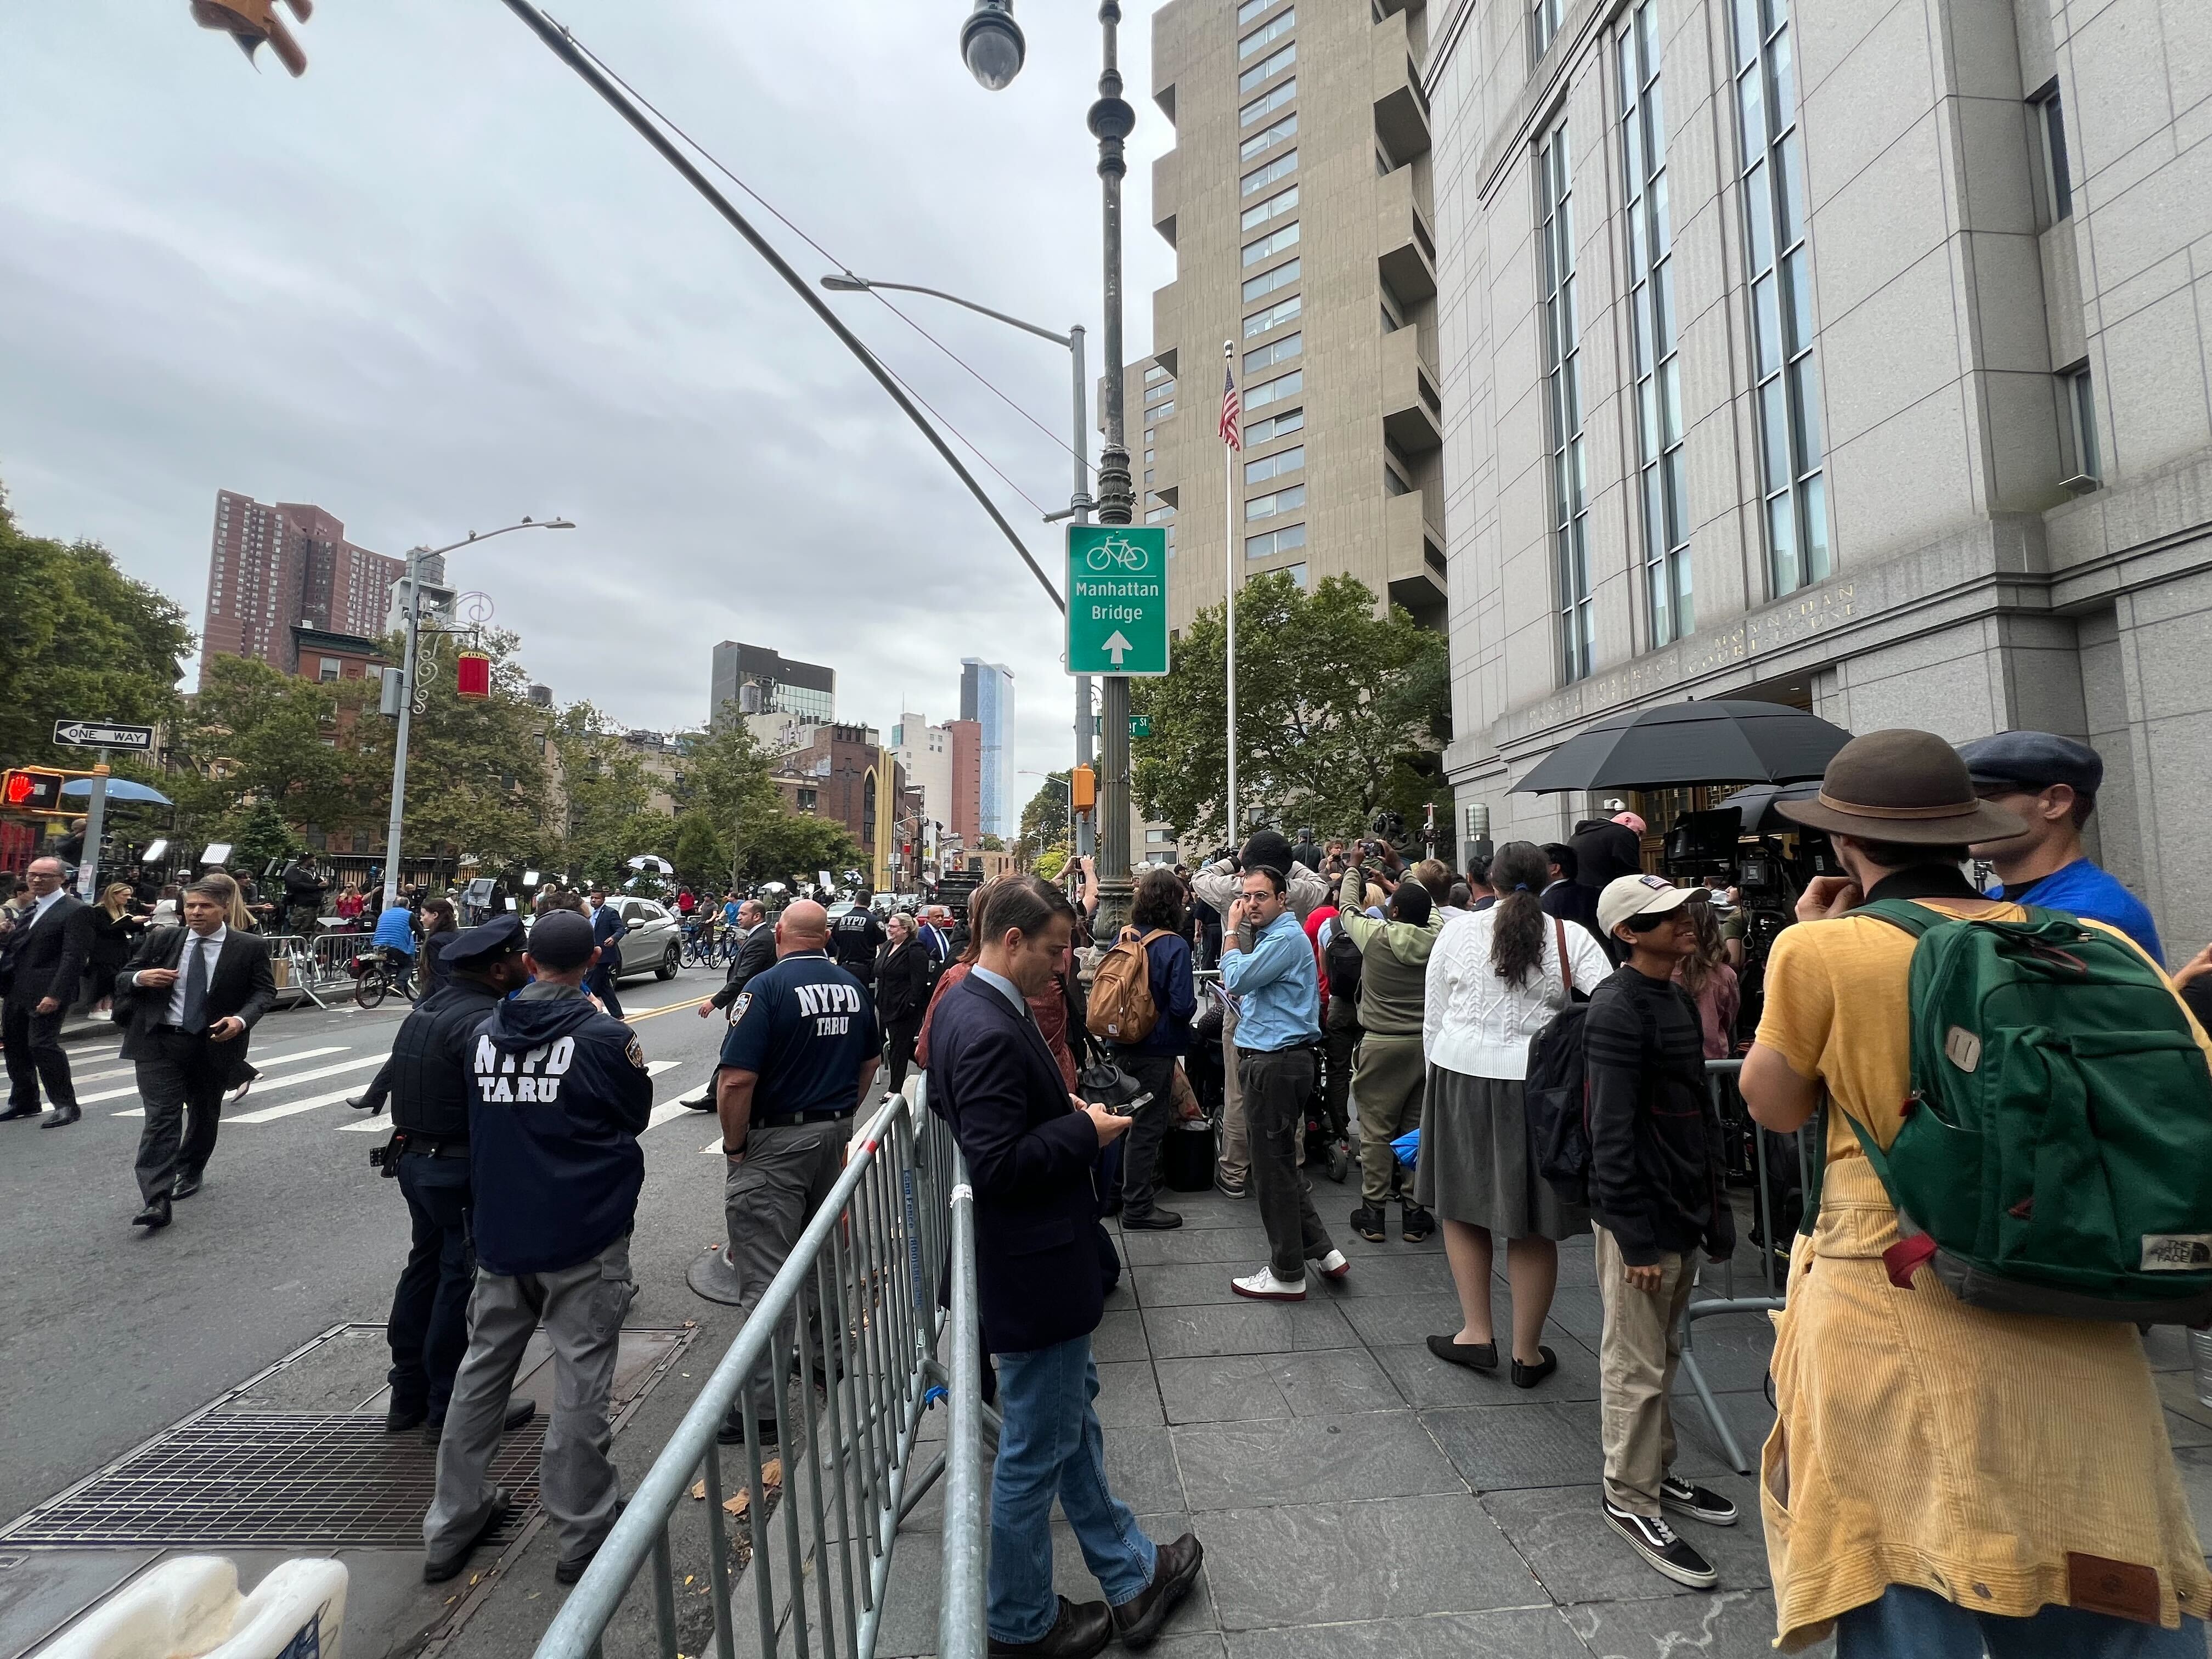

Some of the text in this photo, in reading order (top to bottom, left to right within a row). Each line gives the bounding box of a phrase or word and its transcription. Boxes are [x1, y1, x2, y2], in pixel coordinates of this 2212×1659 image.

[1076, 582, 1159, 596] Manhattan
[1092, 605, 1143, 623] Bridge
[1714, 583, 1854, 648] MOYNIHAN
[1689, 637, 1760, 674] COURT
[1139, 717, 1147, 726] St
[69, 729, 143, 742] ONE WAY
[839, 916, 867, 926] NYPD
[794, 984, 860, 1017] NYPD
[816, 1017, 849, 1036] TARU
[478, 1077, 560, 1103] TARU
[906, 1197, 914, 1229] Fence
[2157, 1254, 2189, 1263] FACE
